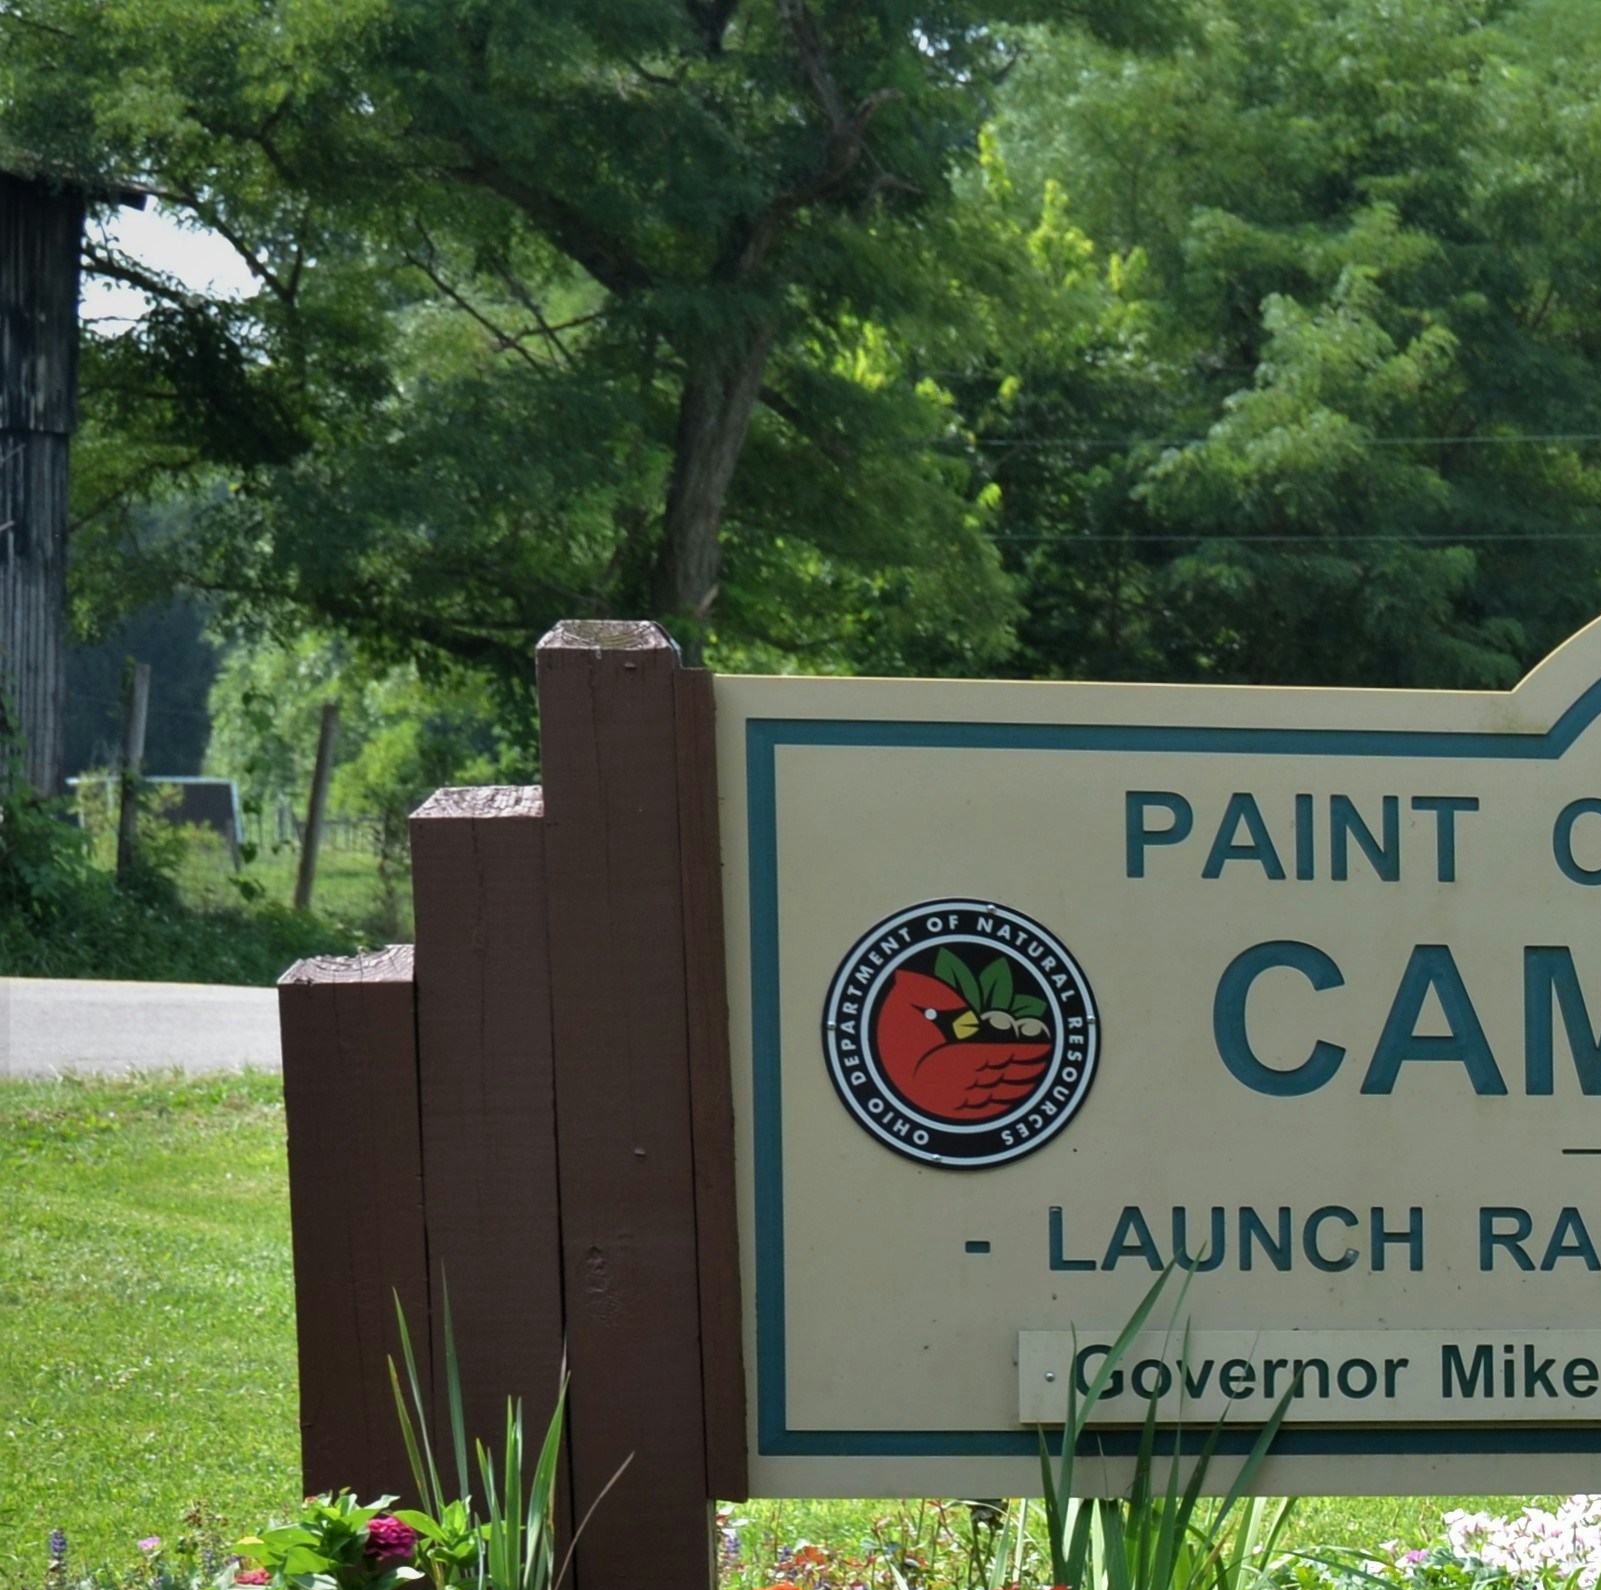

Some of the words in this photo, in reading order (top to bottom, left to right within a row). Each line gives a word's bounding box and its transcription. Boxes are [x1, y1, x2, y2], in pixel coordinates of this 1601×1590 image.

[1125, 790, 1480, 883] PAINT
[926, 914, 959, 933] OF
[976, 916, 1076, 1002] NATURAL
[840, 927, 912, 1087] DEPARTMENT
[1000, 1016, 1085, 1146] RESOURCES
[868, 1097, 930, 1146] OHIO
[1048, 1205, 1424, 1273] LAUNCH
[1075, 1343, 1410, 1400] Governor
[1441, 1344, 1599, 1399] Mike
